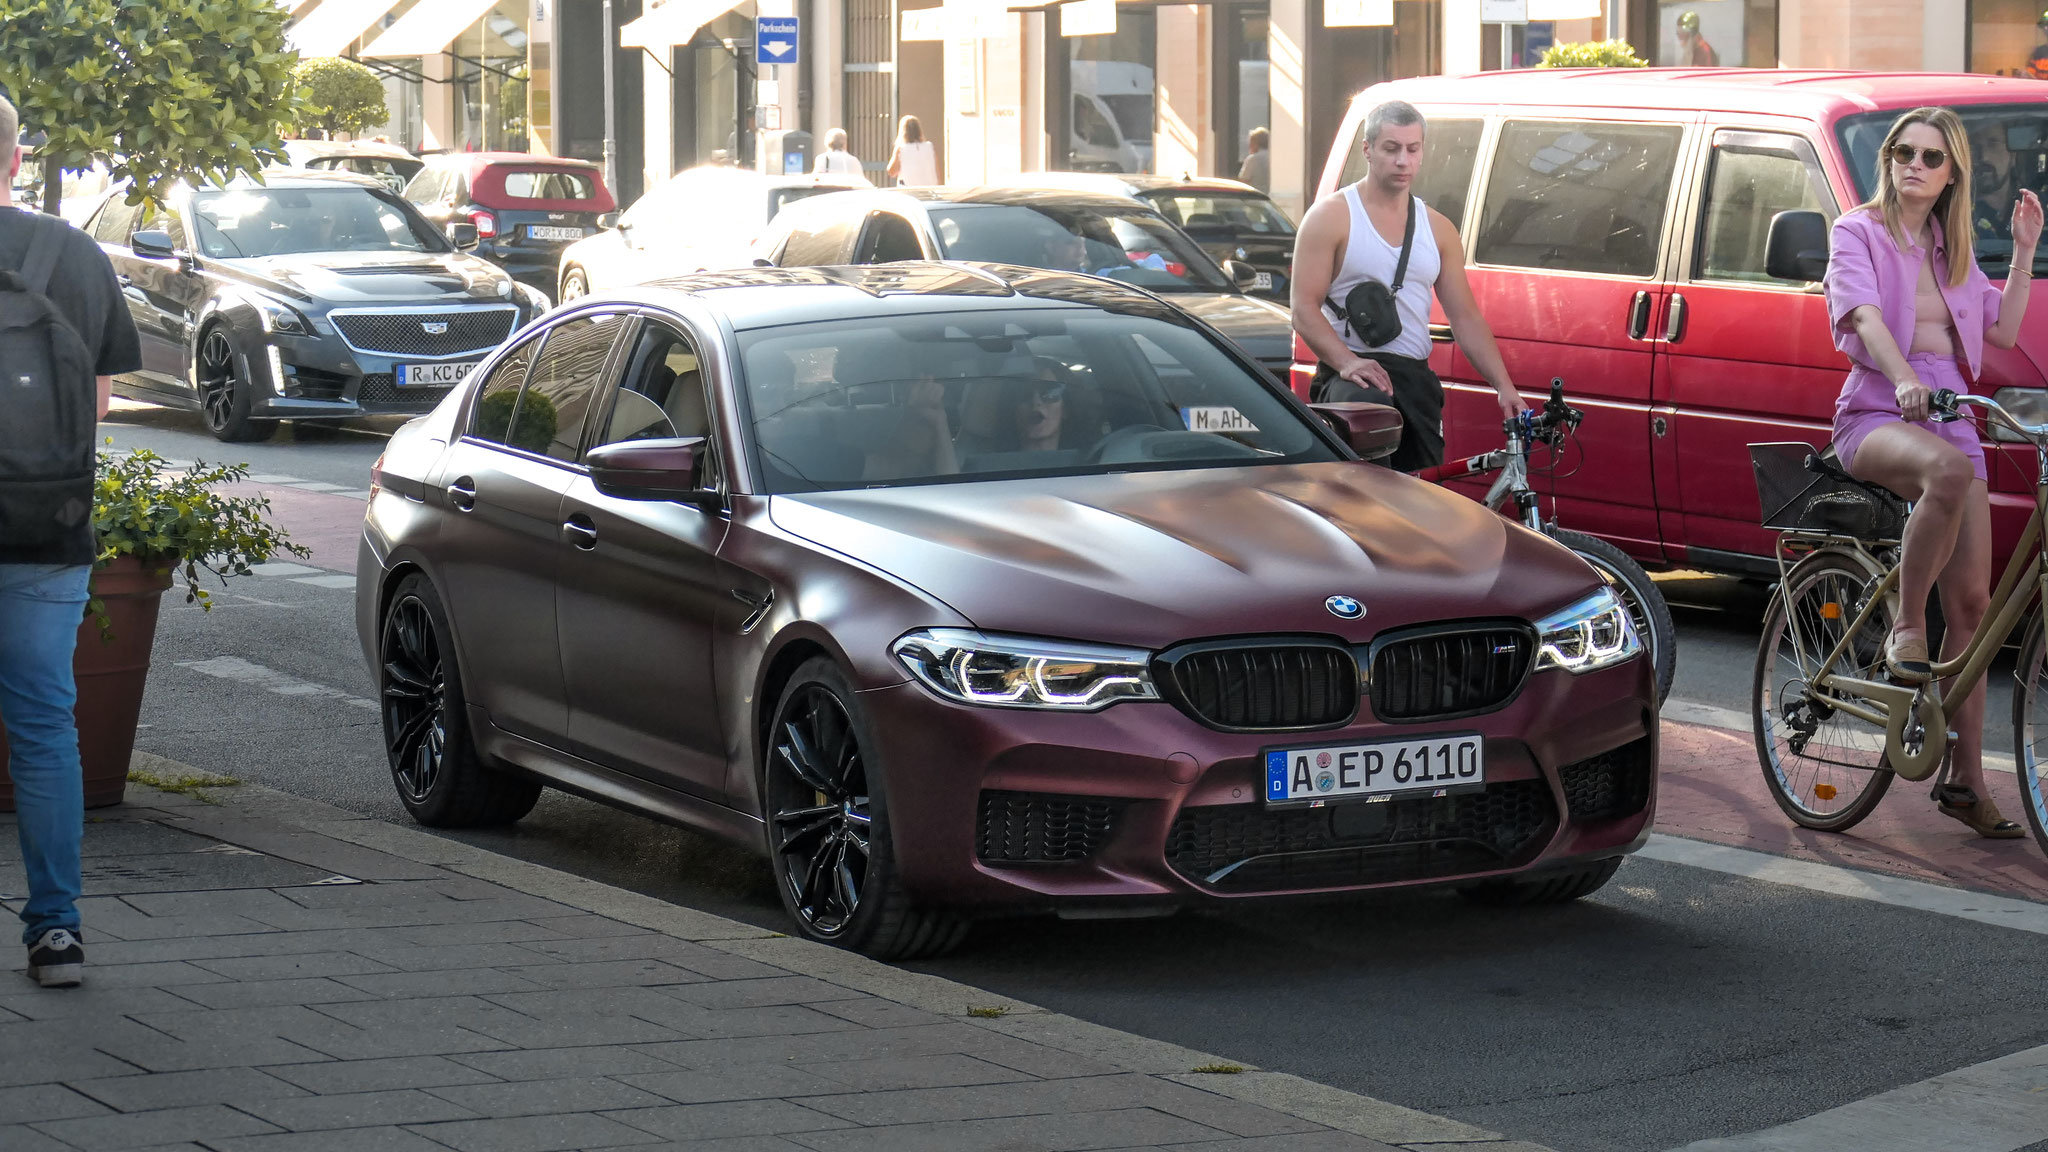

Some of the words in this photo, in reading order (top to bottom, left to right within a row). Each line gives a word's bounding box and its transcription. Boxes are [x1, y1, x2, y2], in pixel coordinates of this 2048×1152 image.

[759, 21, 796, 33] Parkschein
[532, 226, 551, 238] WOR
[557, 228, 563, 238] X
[564, 228, 582, 239] 800
[412, 366, 422, 382] R
[433, 365, 452, 381] KC
[1196, 410, 1209, 429] M
[1220, 410, 1243, 428] AH
[1292, 755, 1314, 793] A
[1339, 750, 1385, 789] EP
[1393, 741, 1478, 784] 6110
[1273, 780, 1282, 791] D
